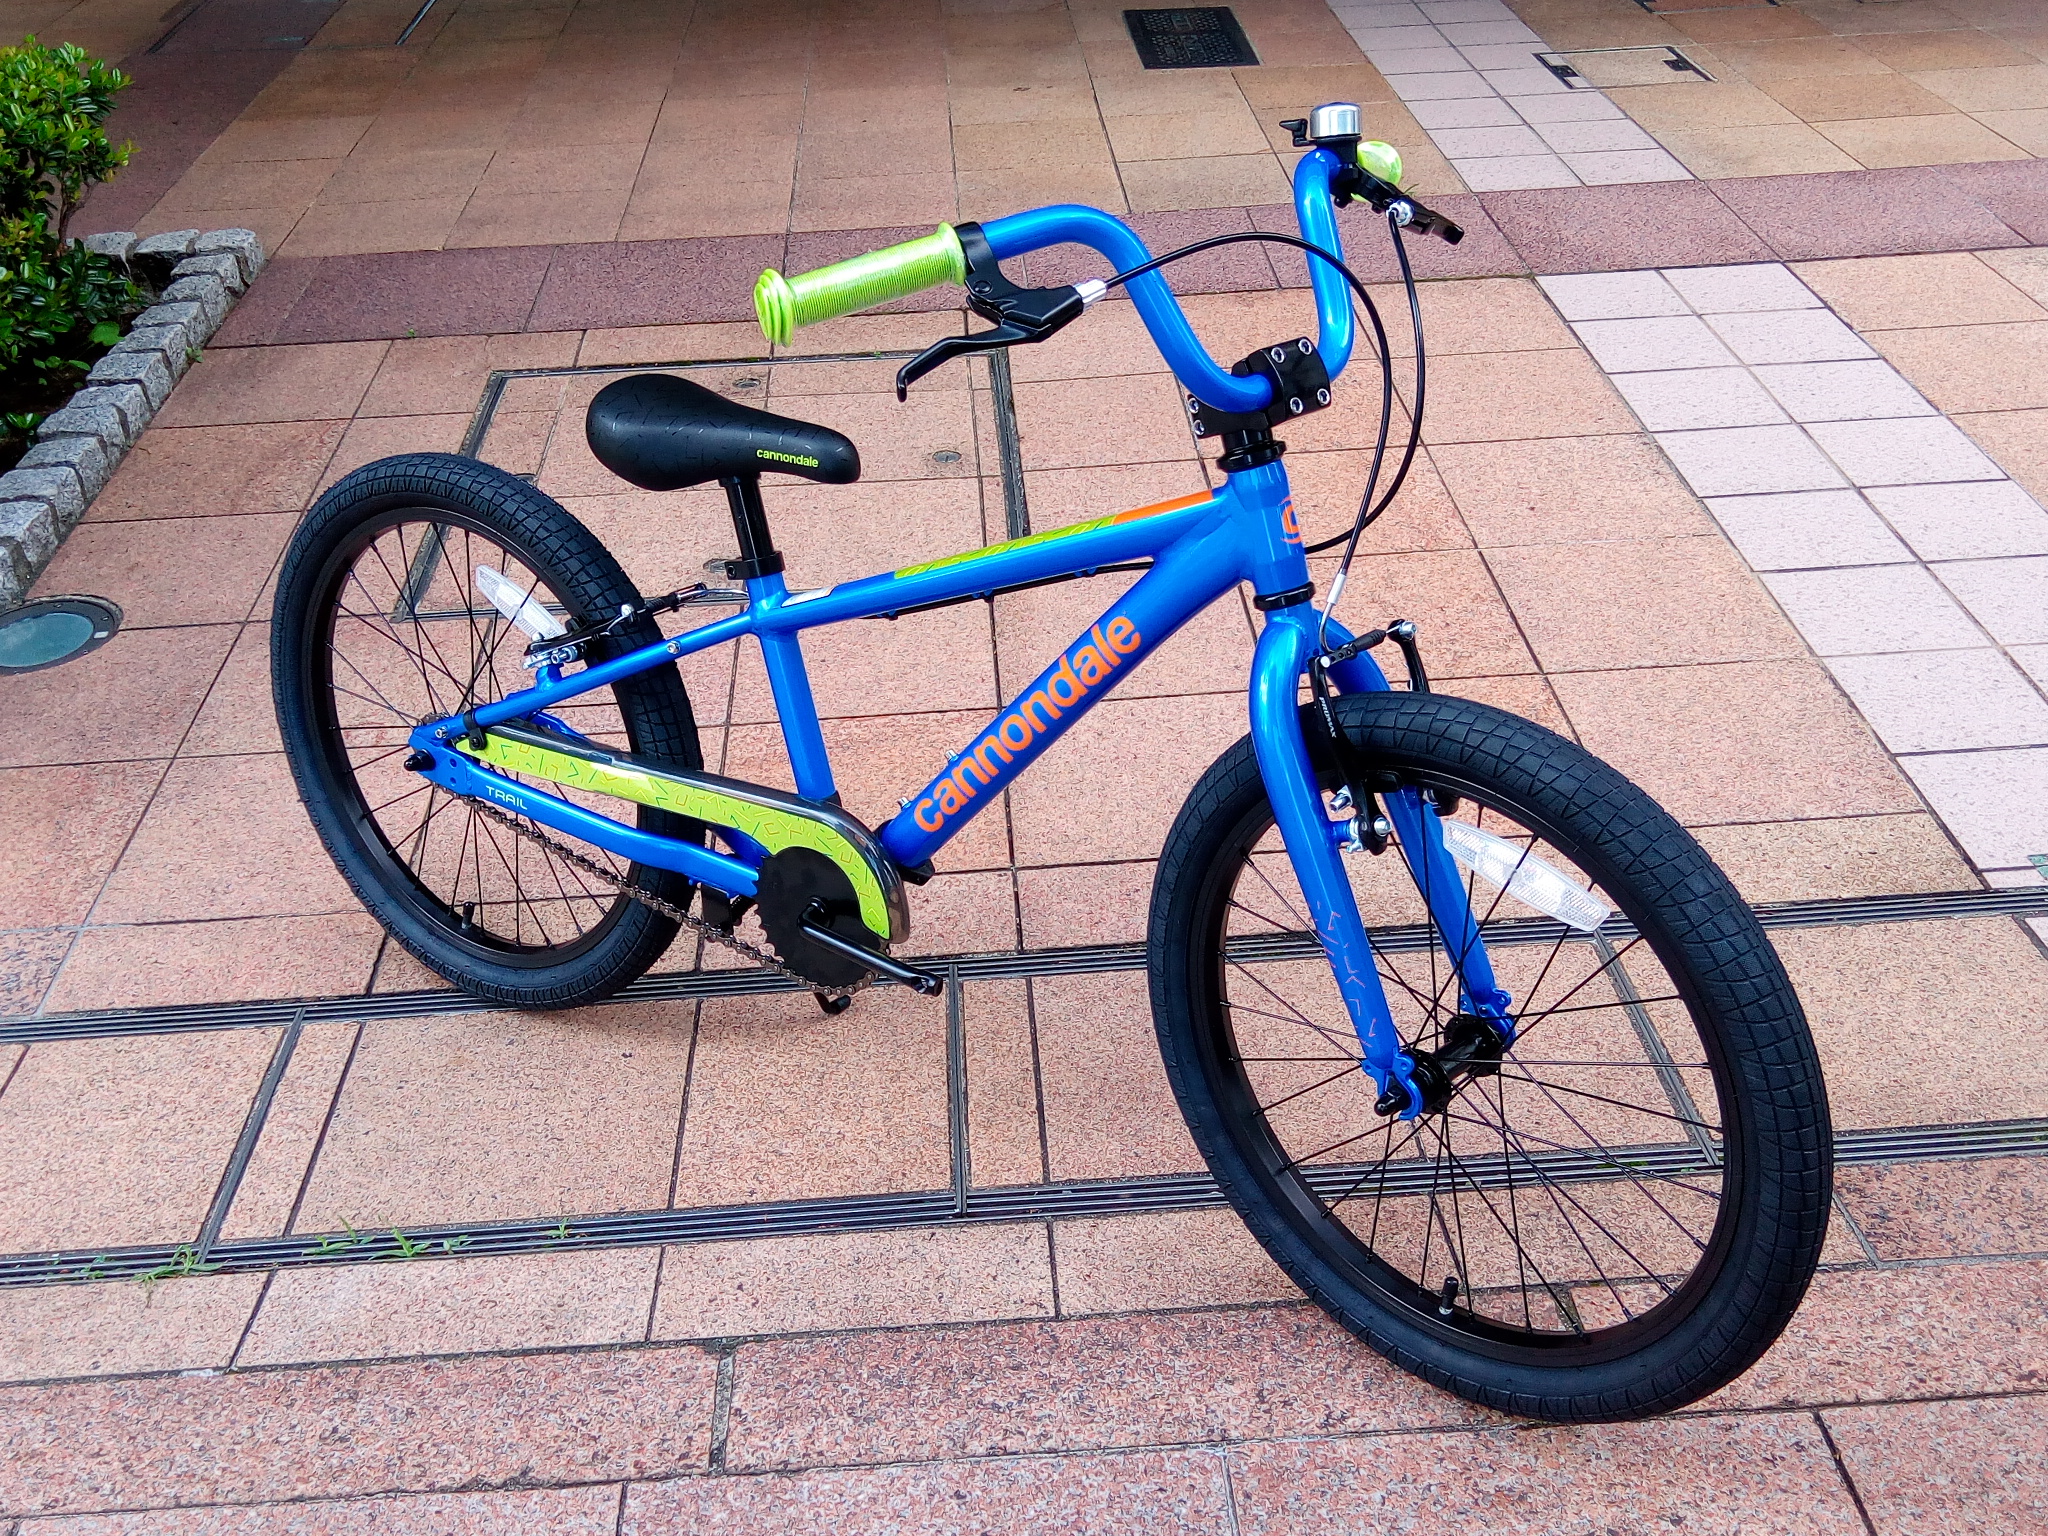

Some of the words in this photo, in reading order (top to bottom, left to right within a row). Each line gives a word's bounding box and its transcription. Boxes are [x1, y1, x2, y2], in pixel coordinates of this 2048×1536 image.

[756, 448, 819, 468] cannondale
[914, 615, 1141, 832] cannondale
[485, 785, 528, 810] TRAIL
